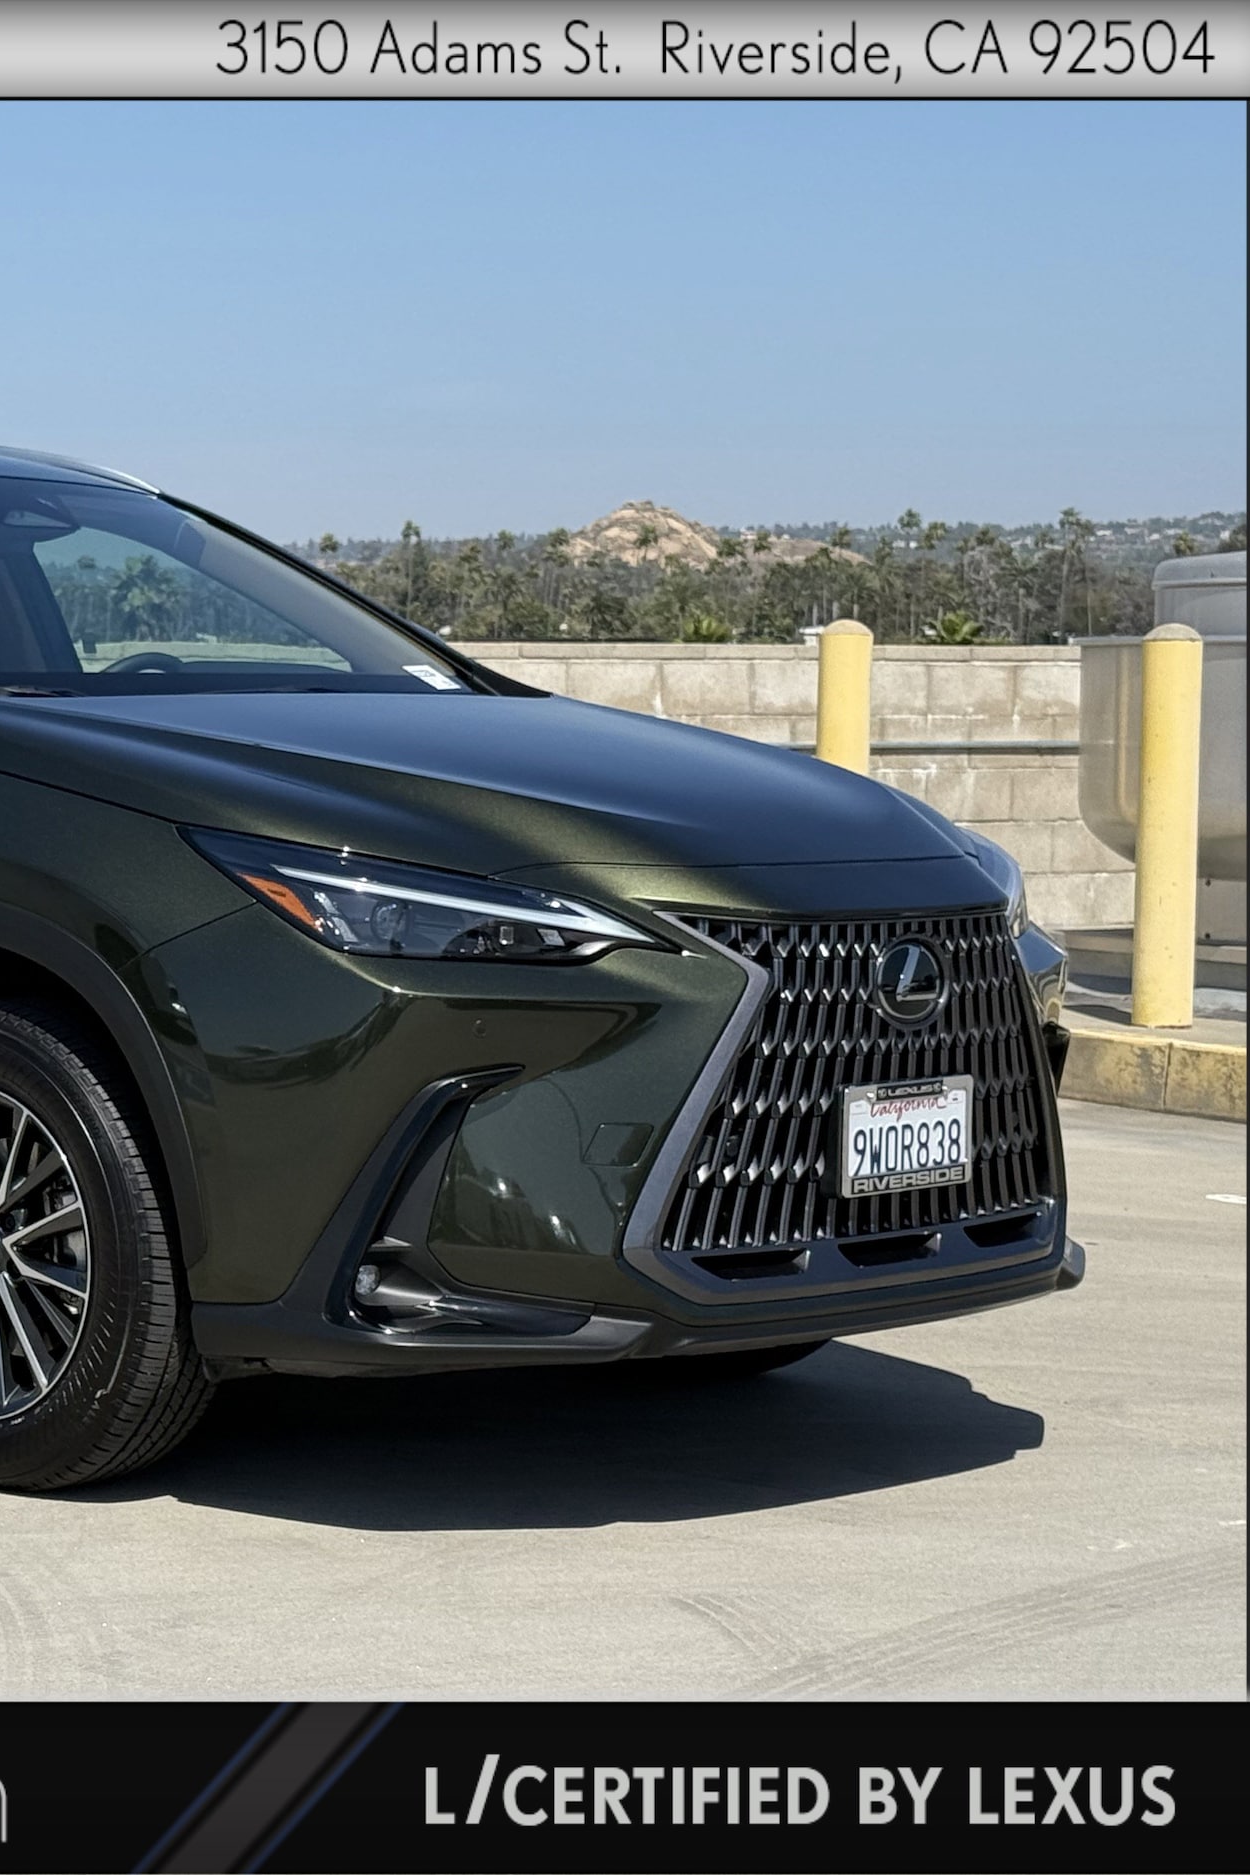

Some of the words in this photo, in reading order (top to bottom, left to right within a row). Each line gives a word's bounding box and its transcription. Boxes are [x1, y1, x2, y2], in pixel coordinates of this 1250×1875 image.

[887, 1084, 934, 1097] LEXUS
[870, 1096, 947, 1122] California
[853, 1166, 964, 1194] RIVERSIDE
